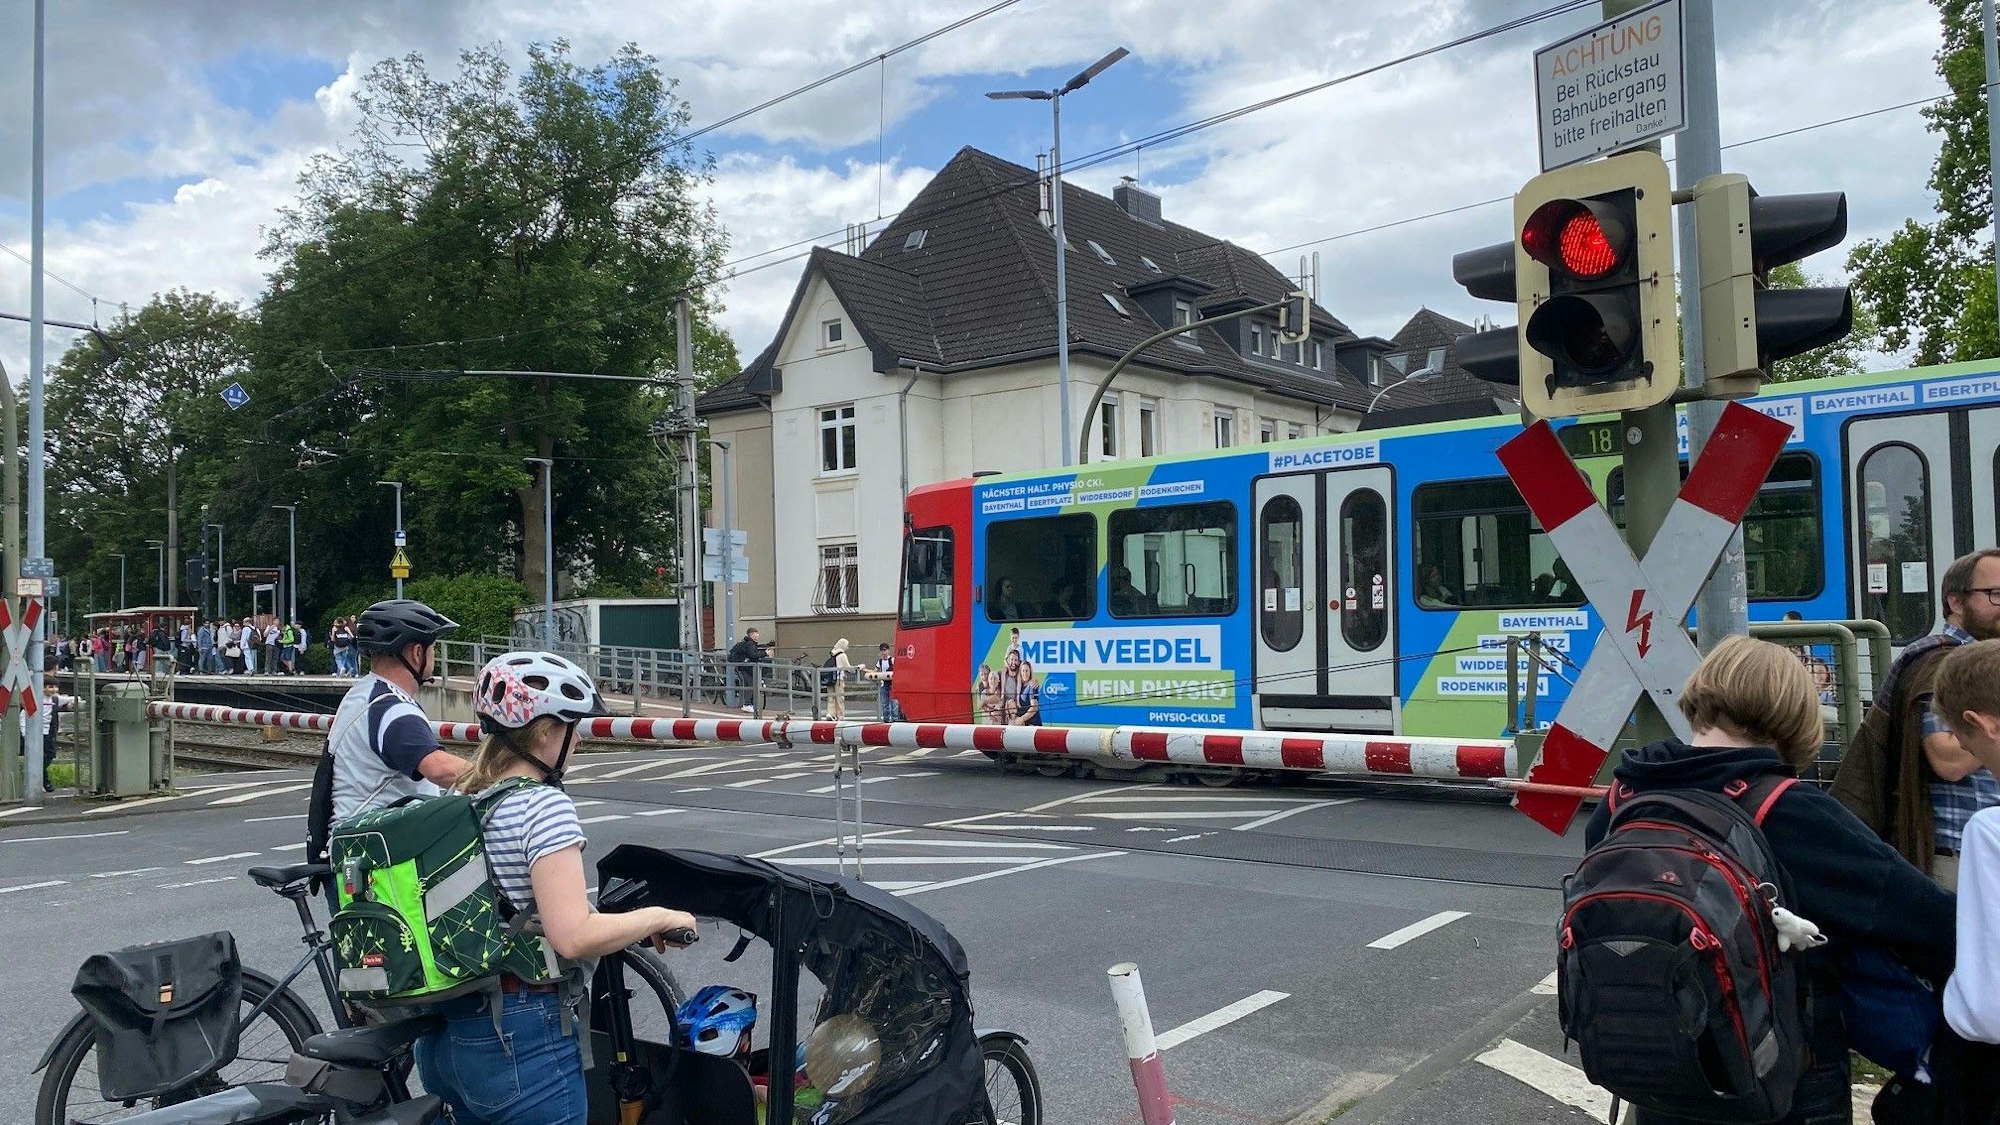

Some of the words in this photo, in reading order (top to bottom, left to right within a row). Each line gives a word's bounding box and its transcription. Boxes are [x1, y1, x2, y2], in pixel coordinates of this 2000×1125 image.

[1552, 16, 1661, 80] ACHTUNG
[1557, 79, 1580, 102] Bei
[1586, 53, 1659, 91] Rückstau
[1552, 72, 1666, 126] Bahnübergang
[1554, 127, 1585, 148] bitte
[1590, 98, 1666, 136] freihalten
[1636, 115, 1667, 133] Danke!
[1816, 390, 1910, 410] BAYENTHAL
[1760, 405, 1797, 418] ALT.
[1588, 428, 1612, 453] 18
[1274, 446, 1375, 468] #PLACETOBE
[982, 485, 1026, 499] NÄCHSTER
[1027, 483, 1051, 495] HALT.
[1052, 480, 1085, 493] PHYSIO
[1079, 490, 1133, 503] WIDDERSDORF
[1140, 483, 1202, 497] RODENKIRCHEN
[984, 501, 1023, 512] BAYENTHAL
[1029, 496, 1072, 508] EBERTPLATZ
[1502, 616, 1583, 628] BAYENTHAL
[1021, 640, 1086, 664] MEIN
[1094, 638, 1211, 664] VEEDEL
[1082, 680, 1136, 698] MEIN
[1142, 680, 1227, 700] PHYSIO
[1441, 682, 1544, 692] RODENKIRHN
[1149, 712, 1226, 724] PHYSIO-CKI.DE
